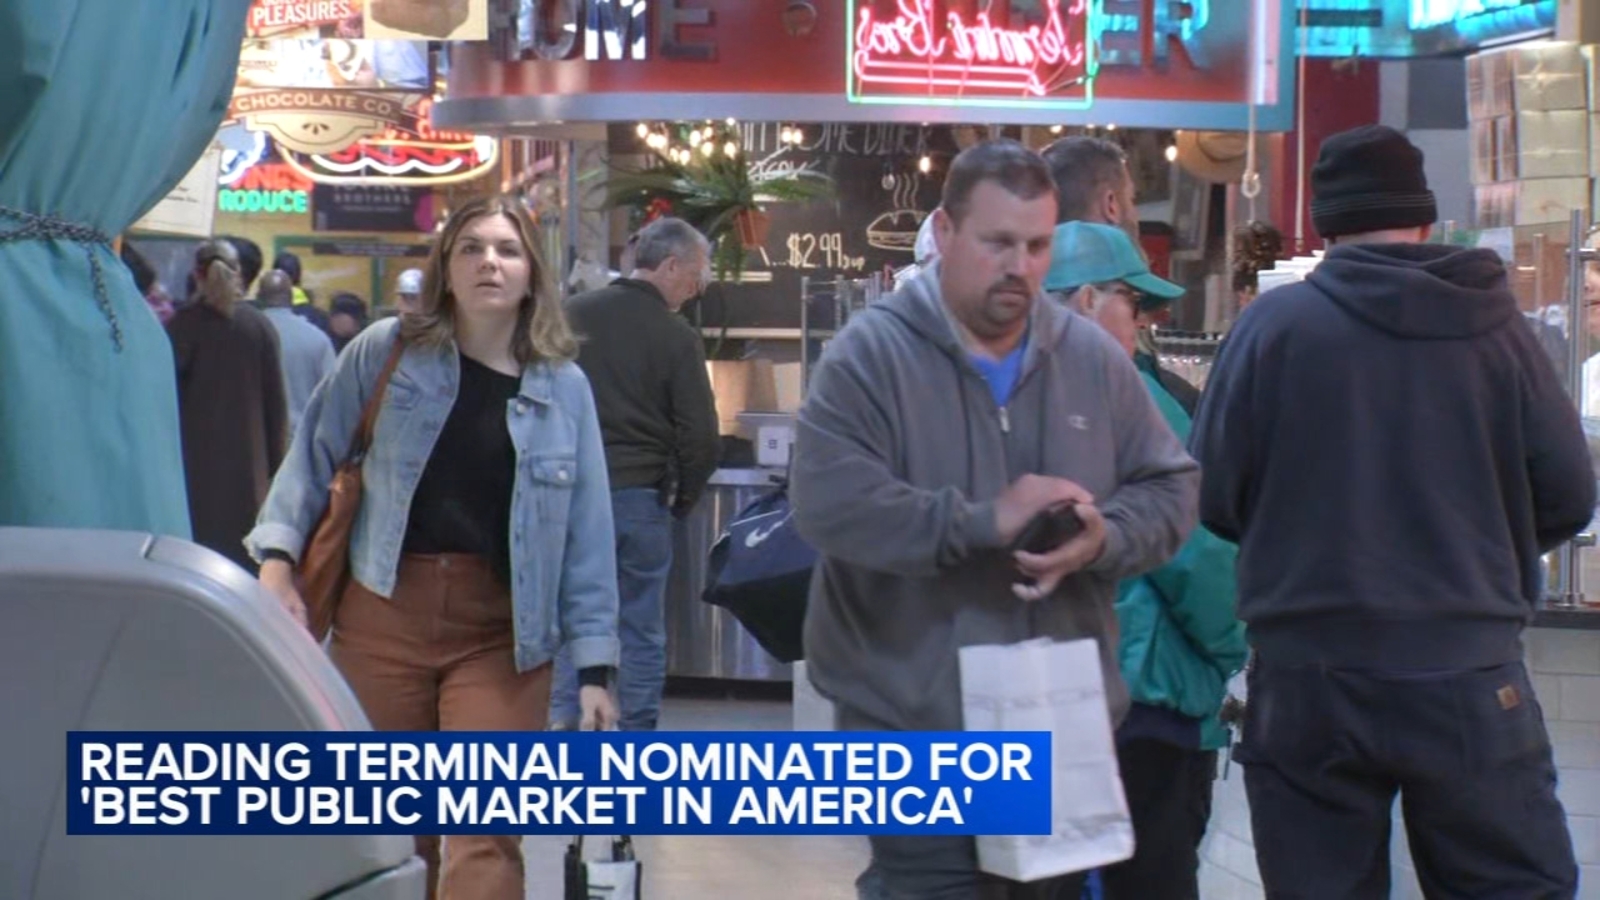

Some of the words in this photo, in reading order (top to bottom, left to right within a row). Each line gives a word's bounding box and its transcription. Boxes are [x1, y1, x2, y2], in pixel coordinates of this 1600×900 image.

[252, 0, 351, 26] PLEASURES
[236, 93, 356, 111] CHOCOLATE
[218, 189, 309, 212] RODUCE
